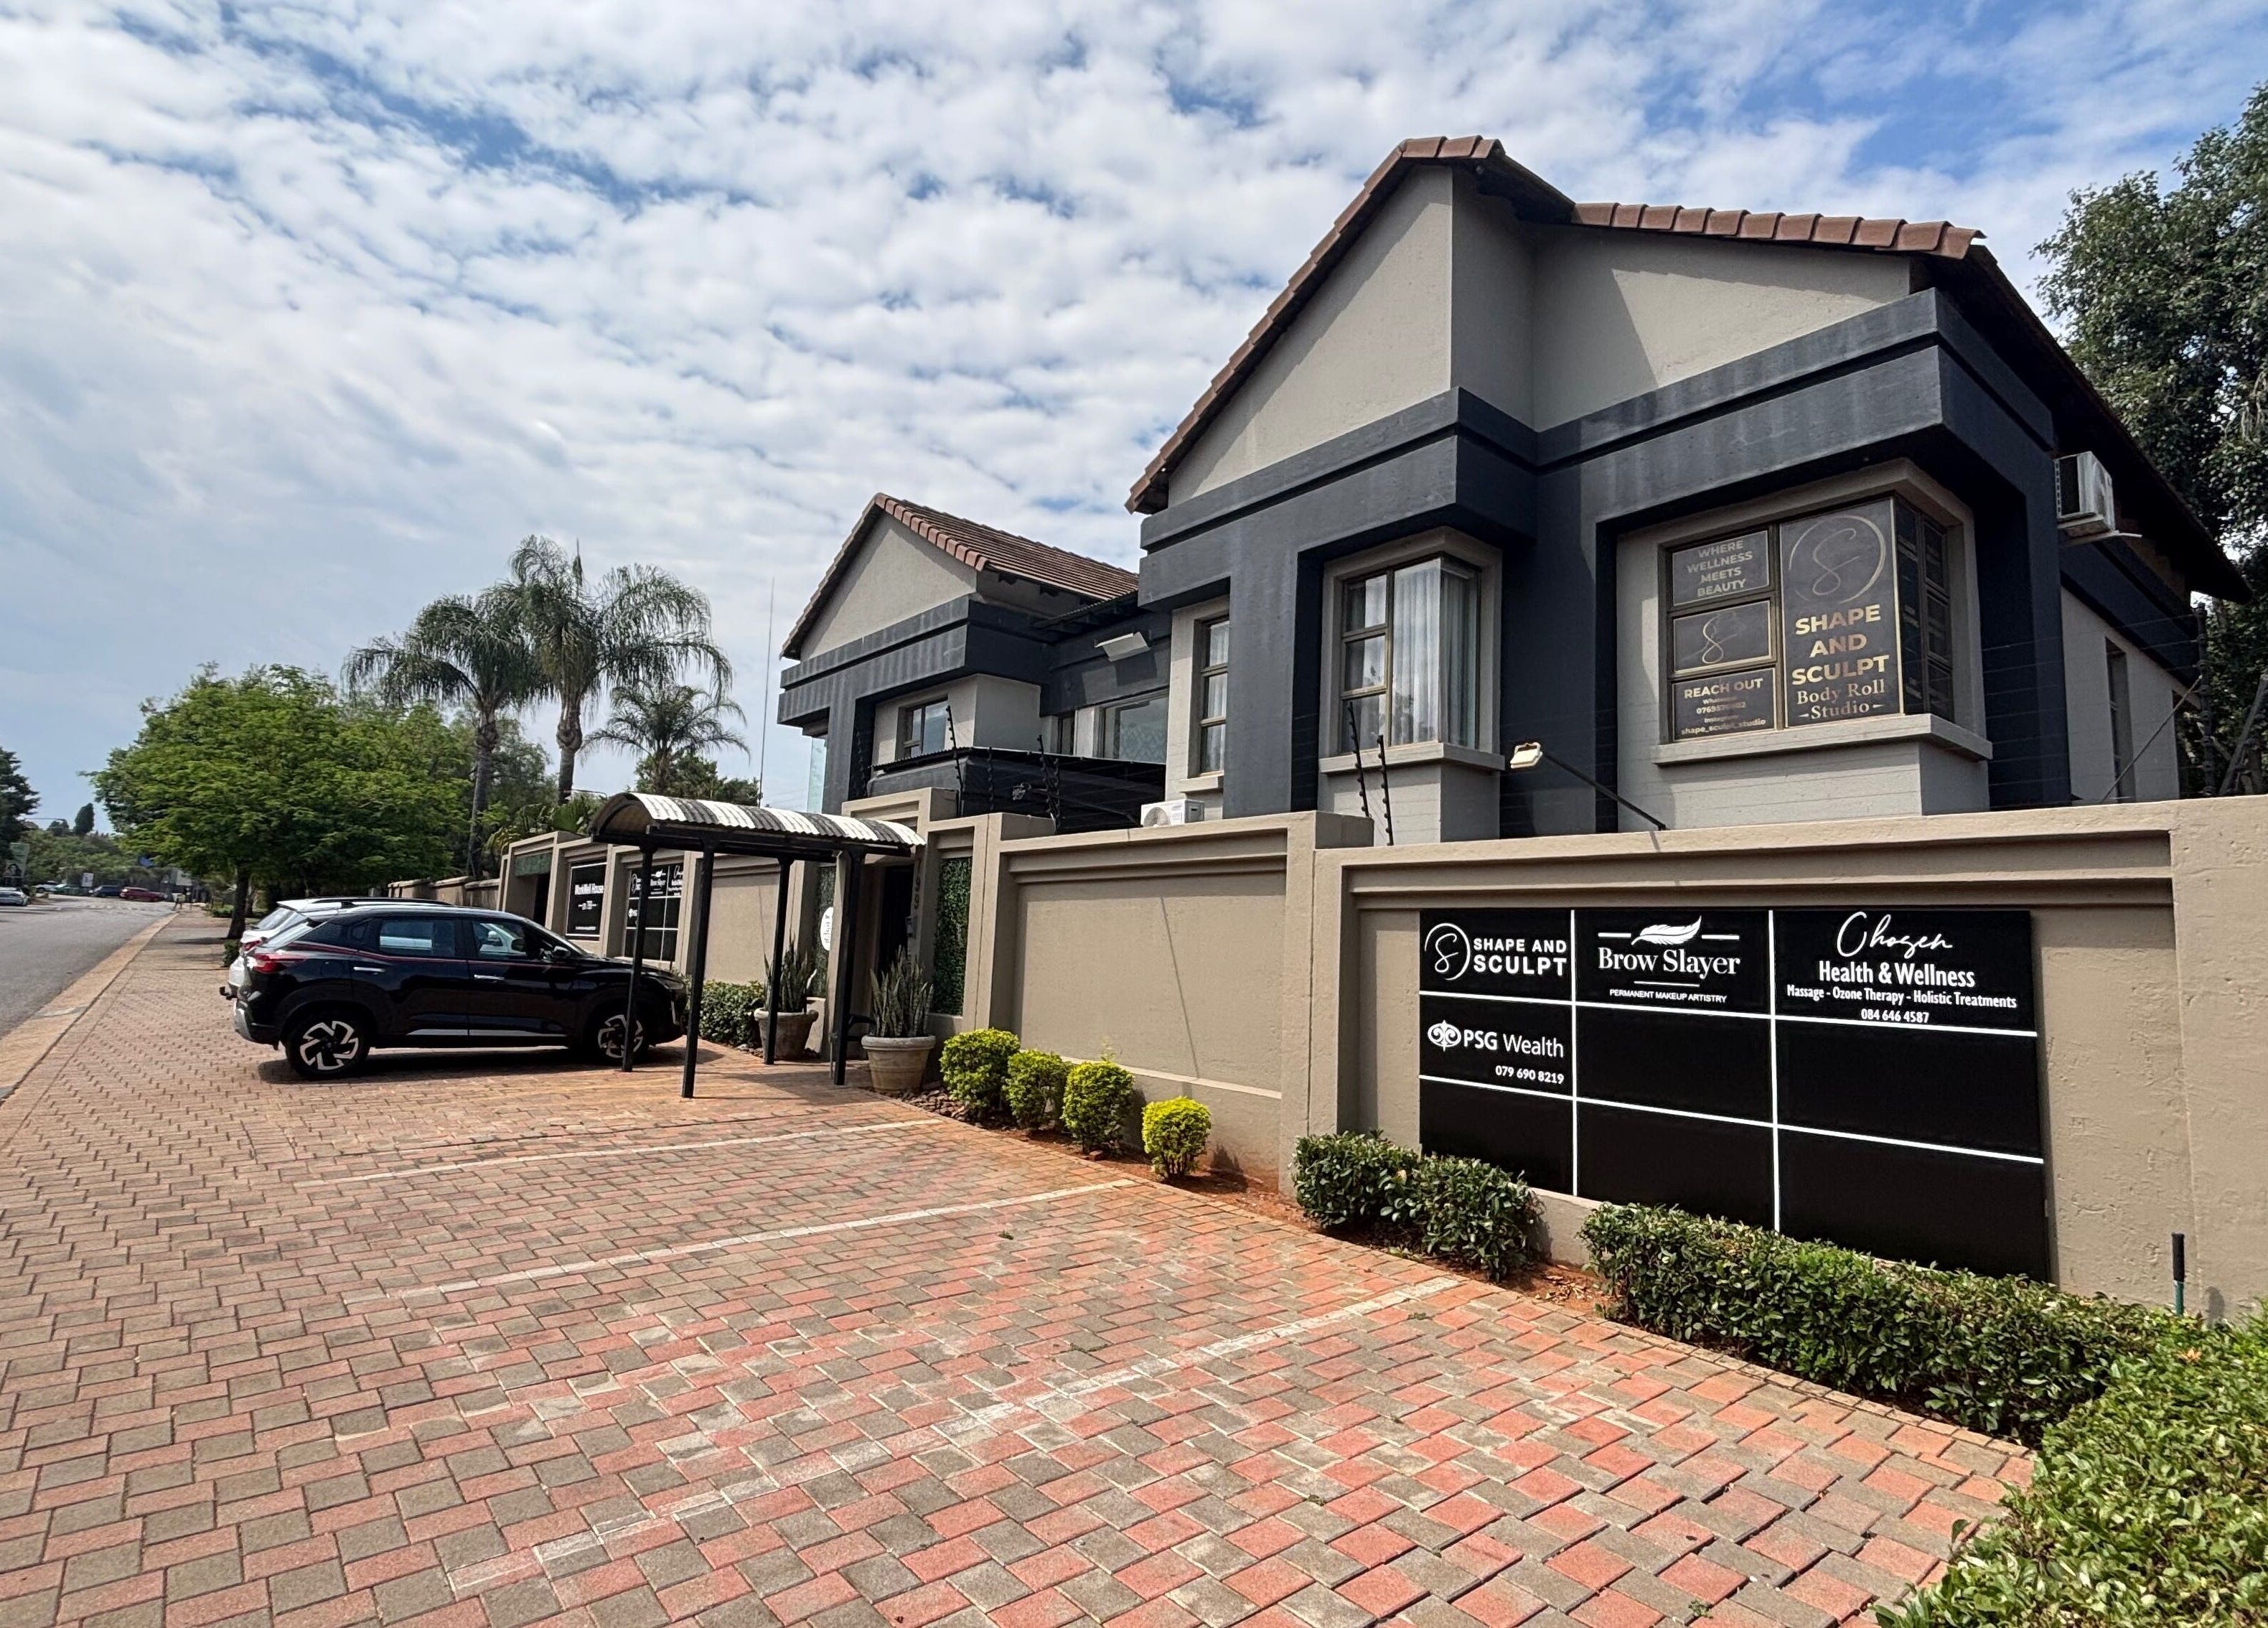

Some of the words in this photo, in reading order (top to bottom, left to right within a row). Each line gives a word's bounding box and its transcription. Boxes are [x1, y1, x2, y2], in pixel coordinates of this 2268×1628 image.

[1698, 540, 1744, 558] WHERE
[1687, 551, 1753, 573] WELLNESS
[1700, 566, 1742, 584] MEETS
[1697, 579, 1746, 597] BEAUTY
[1795, 604, 1881, 635] SHAPE
[1809, 633, 1868, 658] AND
[1791, 655, 1890, 686] SCULPT
[1684, 683, 1730, 699] REACH
[1734, 678, 1763, 691] OUT
[1796, 686, 1840, 705] Body
[1848, 678, 1885, 697] Roll
[1811, 700, 1870, 719] Studio
[1473, 937, 1525, 952] SHAPE
[1532, 939, 1567, 953] AND
[1473, 954, 1568, 976] SCULPT
[1598, 947, 1659, 972] Brow
[1663, 948, 1741, 980] Slayer
[1819, 960, 1874, 983] Health
[1878, 961, 1893, 984] &
[1894, 962, 1976, 988] Wellness
[1609, 988, 1654, 998] PERMANENT
[1655, 991, 1687, 1001] MAKEUP
[1687, 993, 1728, 1003] ARTISTRY
[1786, 984, 1824, 1001] Massage
[1832, 986, 1862, 1000] Ozone
[1864, 987, 1905, 1006] Therapy
[1913, 989, 1953, 1005] Holistic
[1953, 991, 2018, 1009] Treatments
[1860, 1008, 1880, 1020] 084
[1882, 1009, 1902, 1021] 646
[1903, 1011, 1930, 1023] 4587
[1463, 1029, 1498, 1050] PSG
[1502, 1033, 1565, 1058] Wealth
[1495, 1065, 1514, 1077] 079
[1517, 1067, 1536, 1080] 690
[1537, 1070, 1565, 1085] 8219
